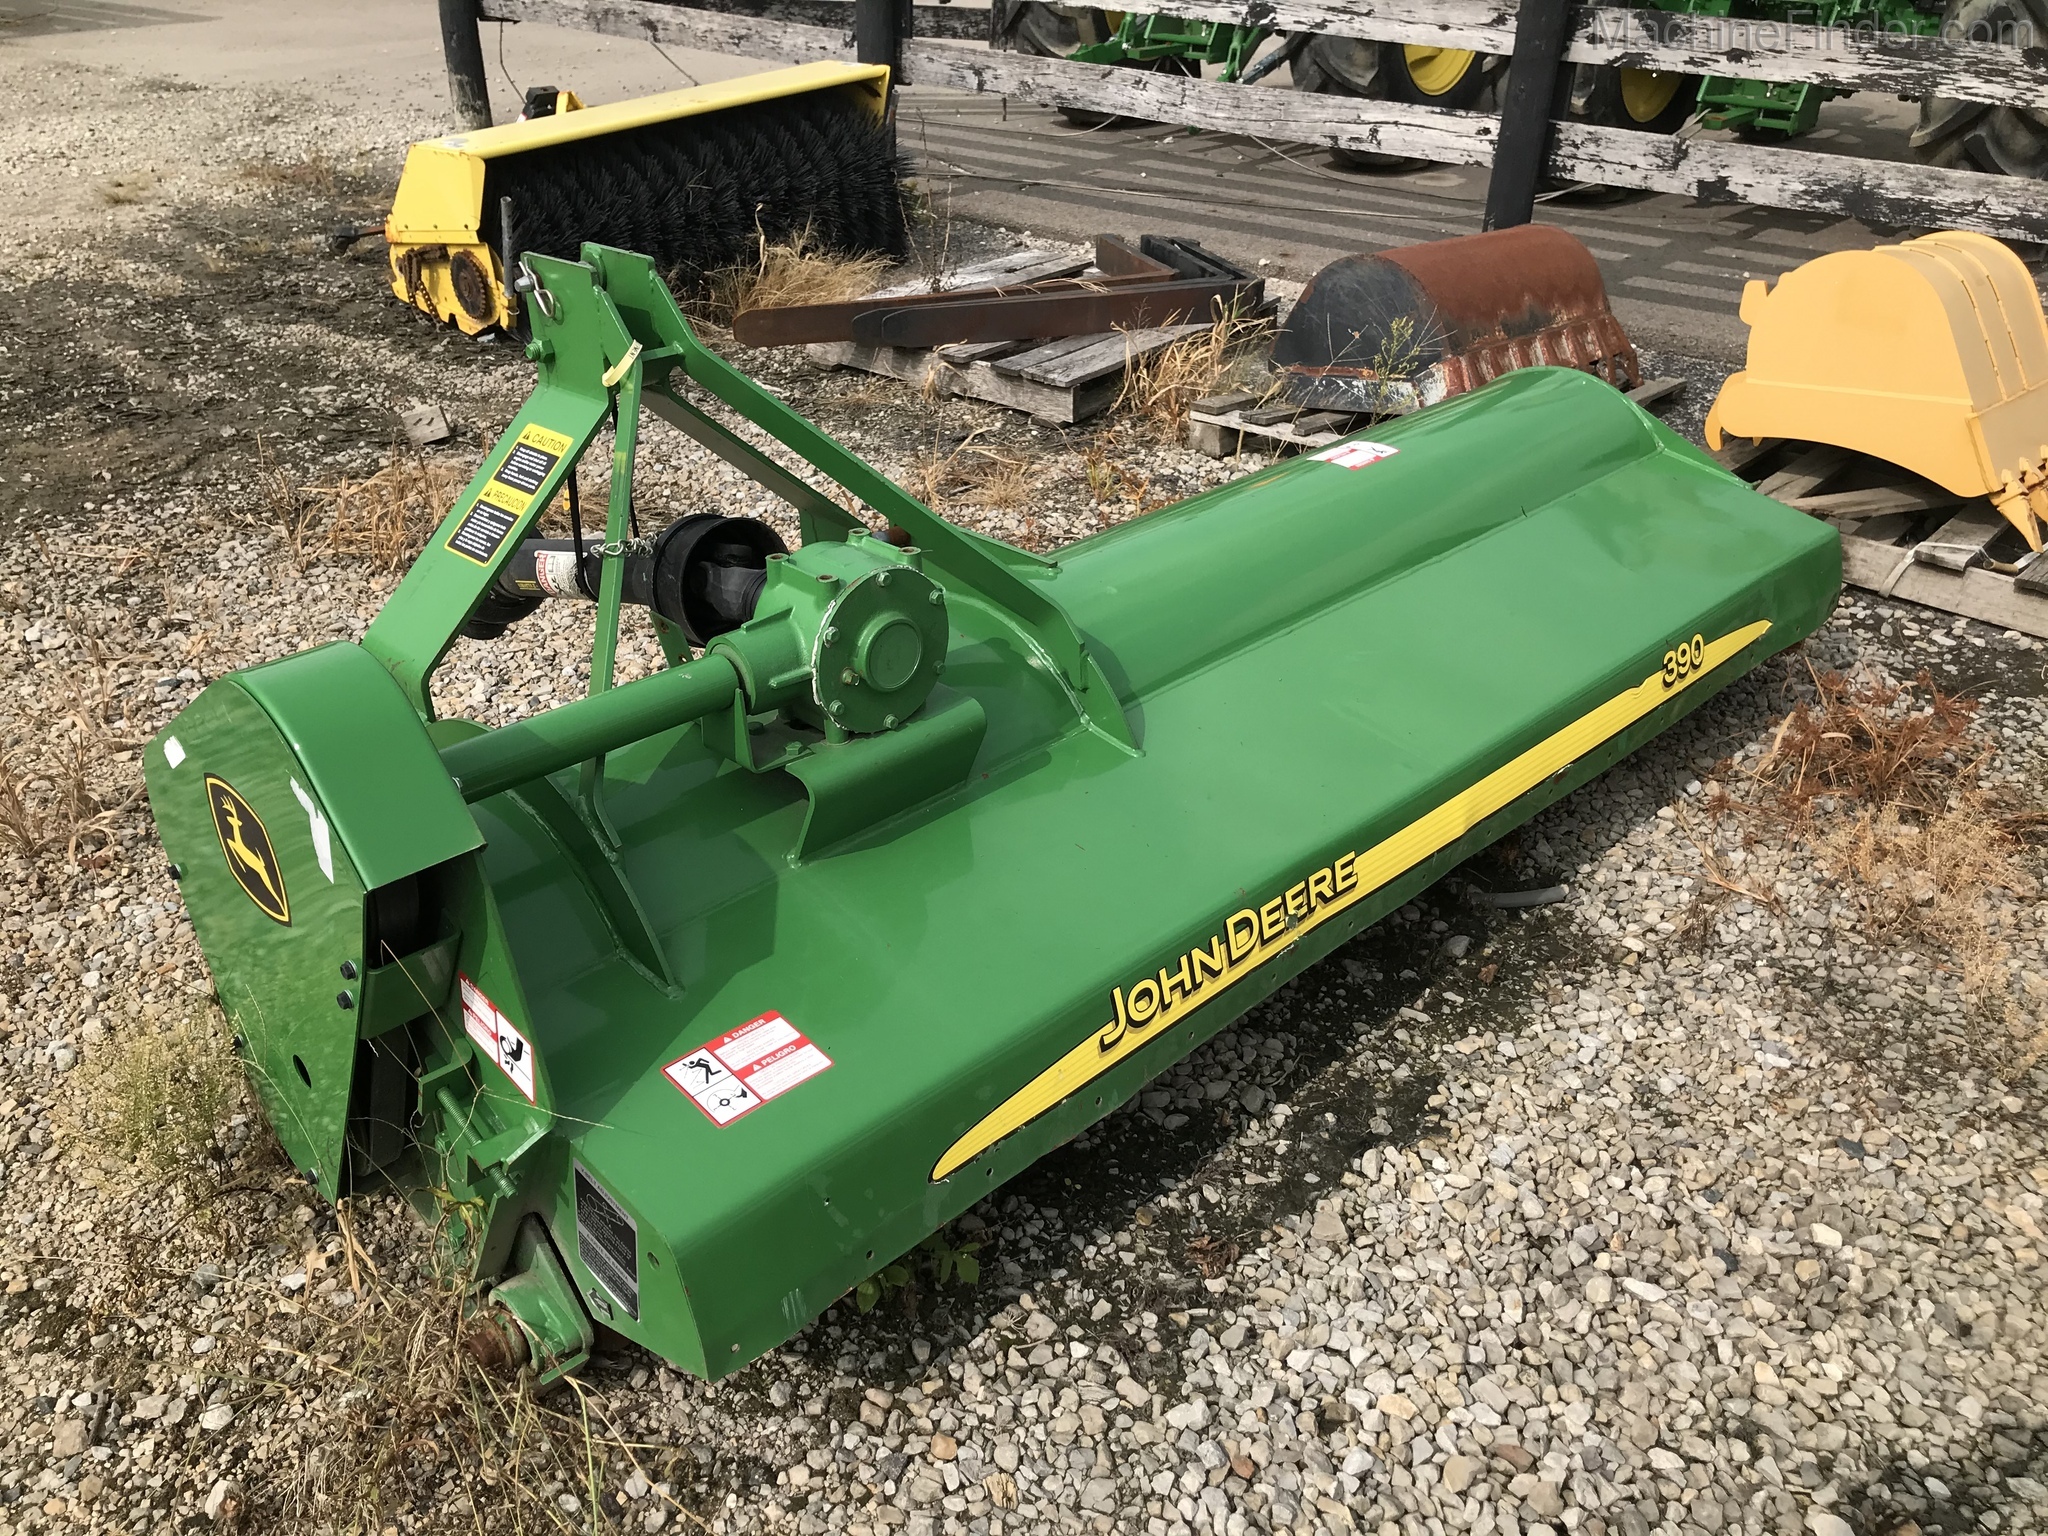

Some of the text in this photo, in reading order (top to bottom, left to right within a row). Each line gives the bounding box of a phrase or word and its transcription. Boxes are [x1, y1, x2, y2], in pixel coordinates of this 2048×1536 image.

[532, 433, 567, 453] CAUTION
[1662, 632, 1704, 688] 390
[1099, 850, 1358, 1052] JOHN DEERE
[731, 1018, 766, 1039] DANGER
[760, 1045, 797, 1066] PELIGRO
